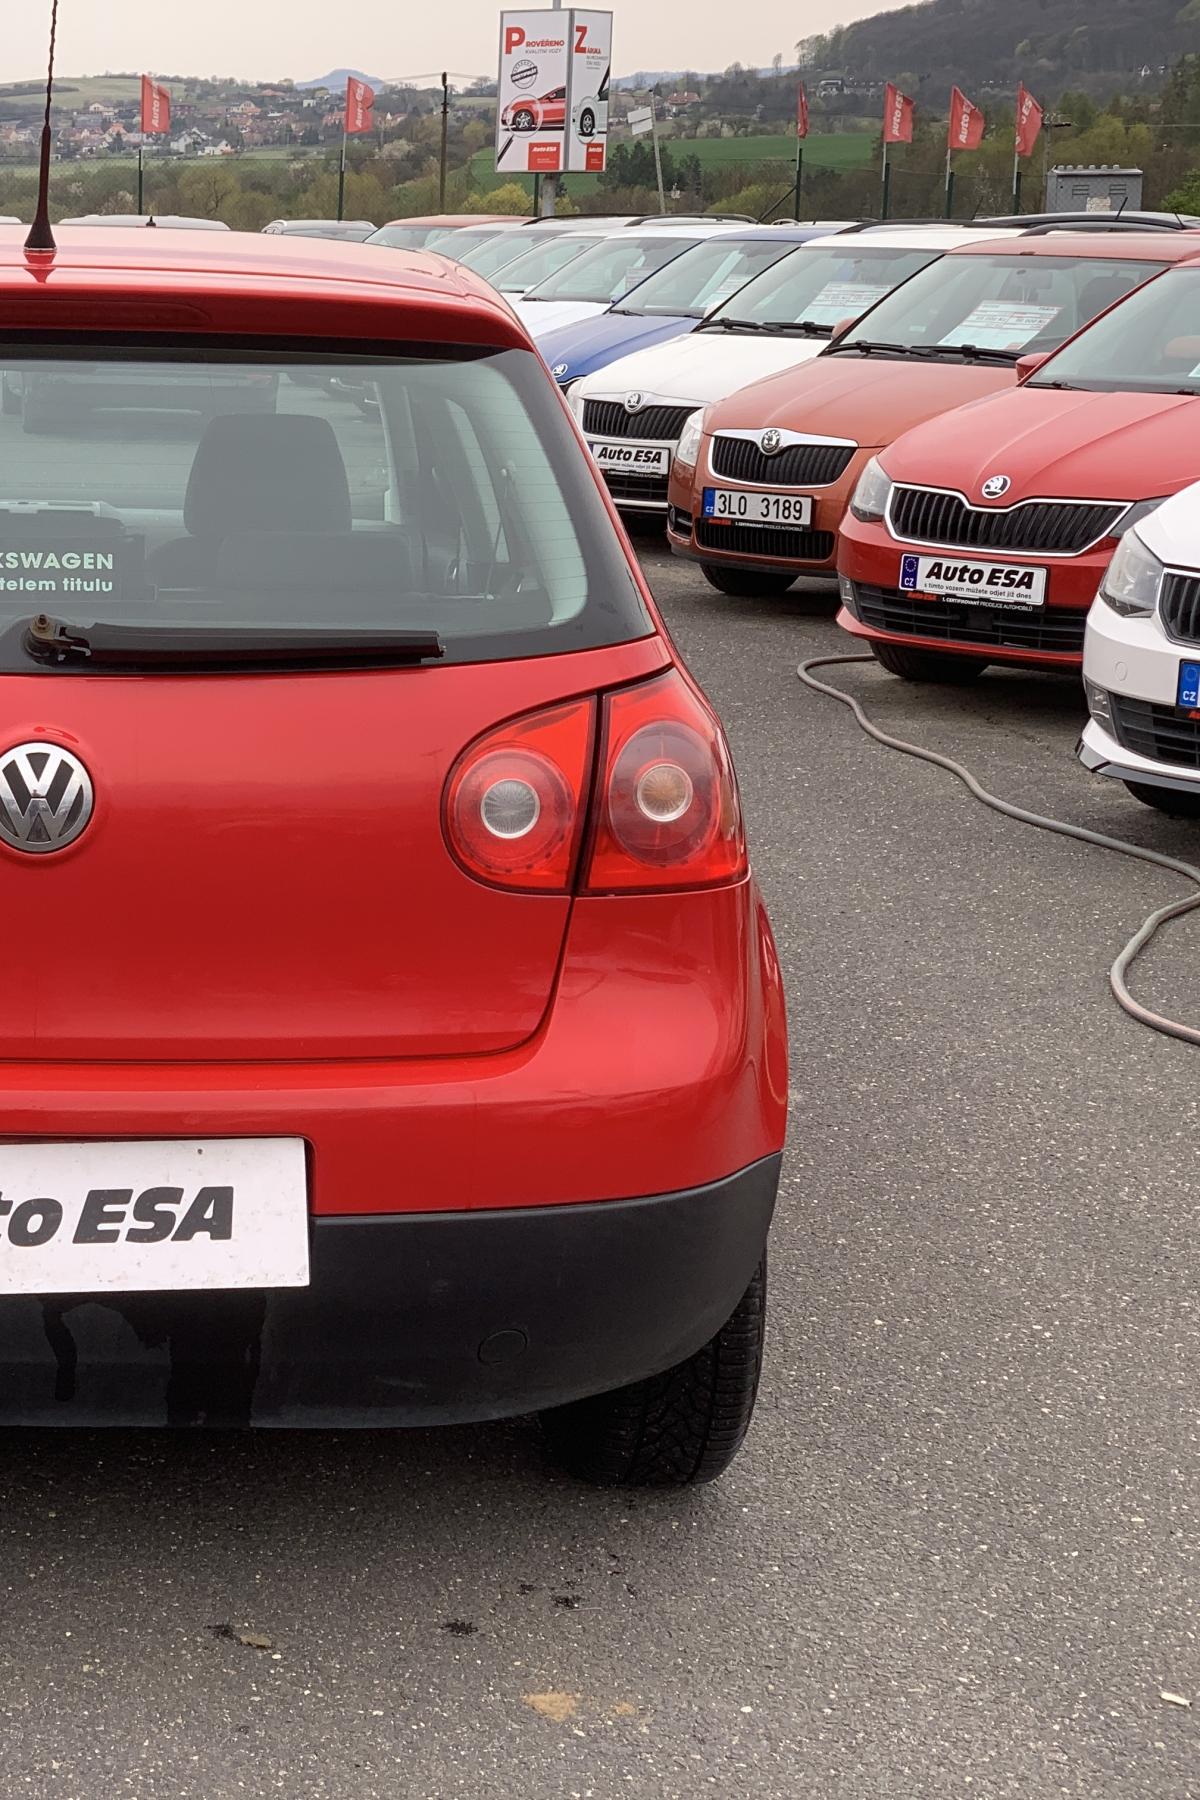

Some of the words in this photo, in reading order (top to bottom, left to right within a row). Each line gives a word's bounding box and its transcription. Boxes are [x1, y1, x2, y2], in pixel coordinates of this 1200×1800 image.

[597, 446, 632, 461] Auto
[633, 450, 662, 464] ESA
[760, 497, 803, 521] 3189
[904, 577, 915, 587] CZ
[925, 562, 985, 584] Auto
[986, 567, 1035, 590] ESA
[62, 577, 113, 592] titulu
[1016, 592, 1032, 600] dnes
[1182, 690, 1197, 702] CZ
[72, 1186, 234, 1244] ESA
